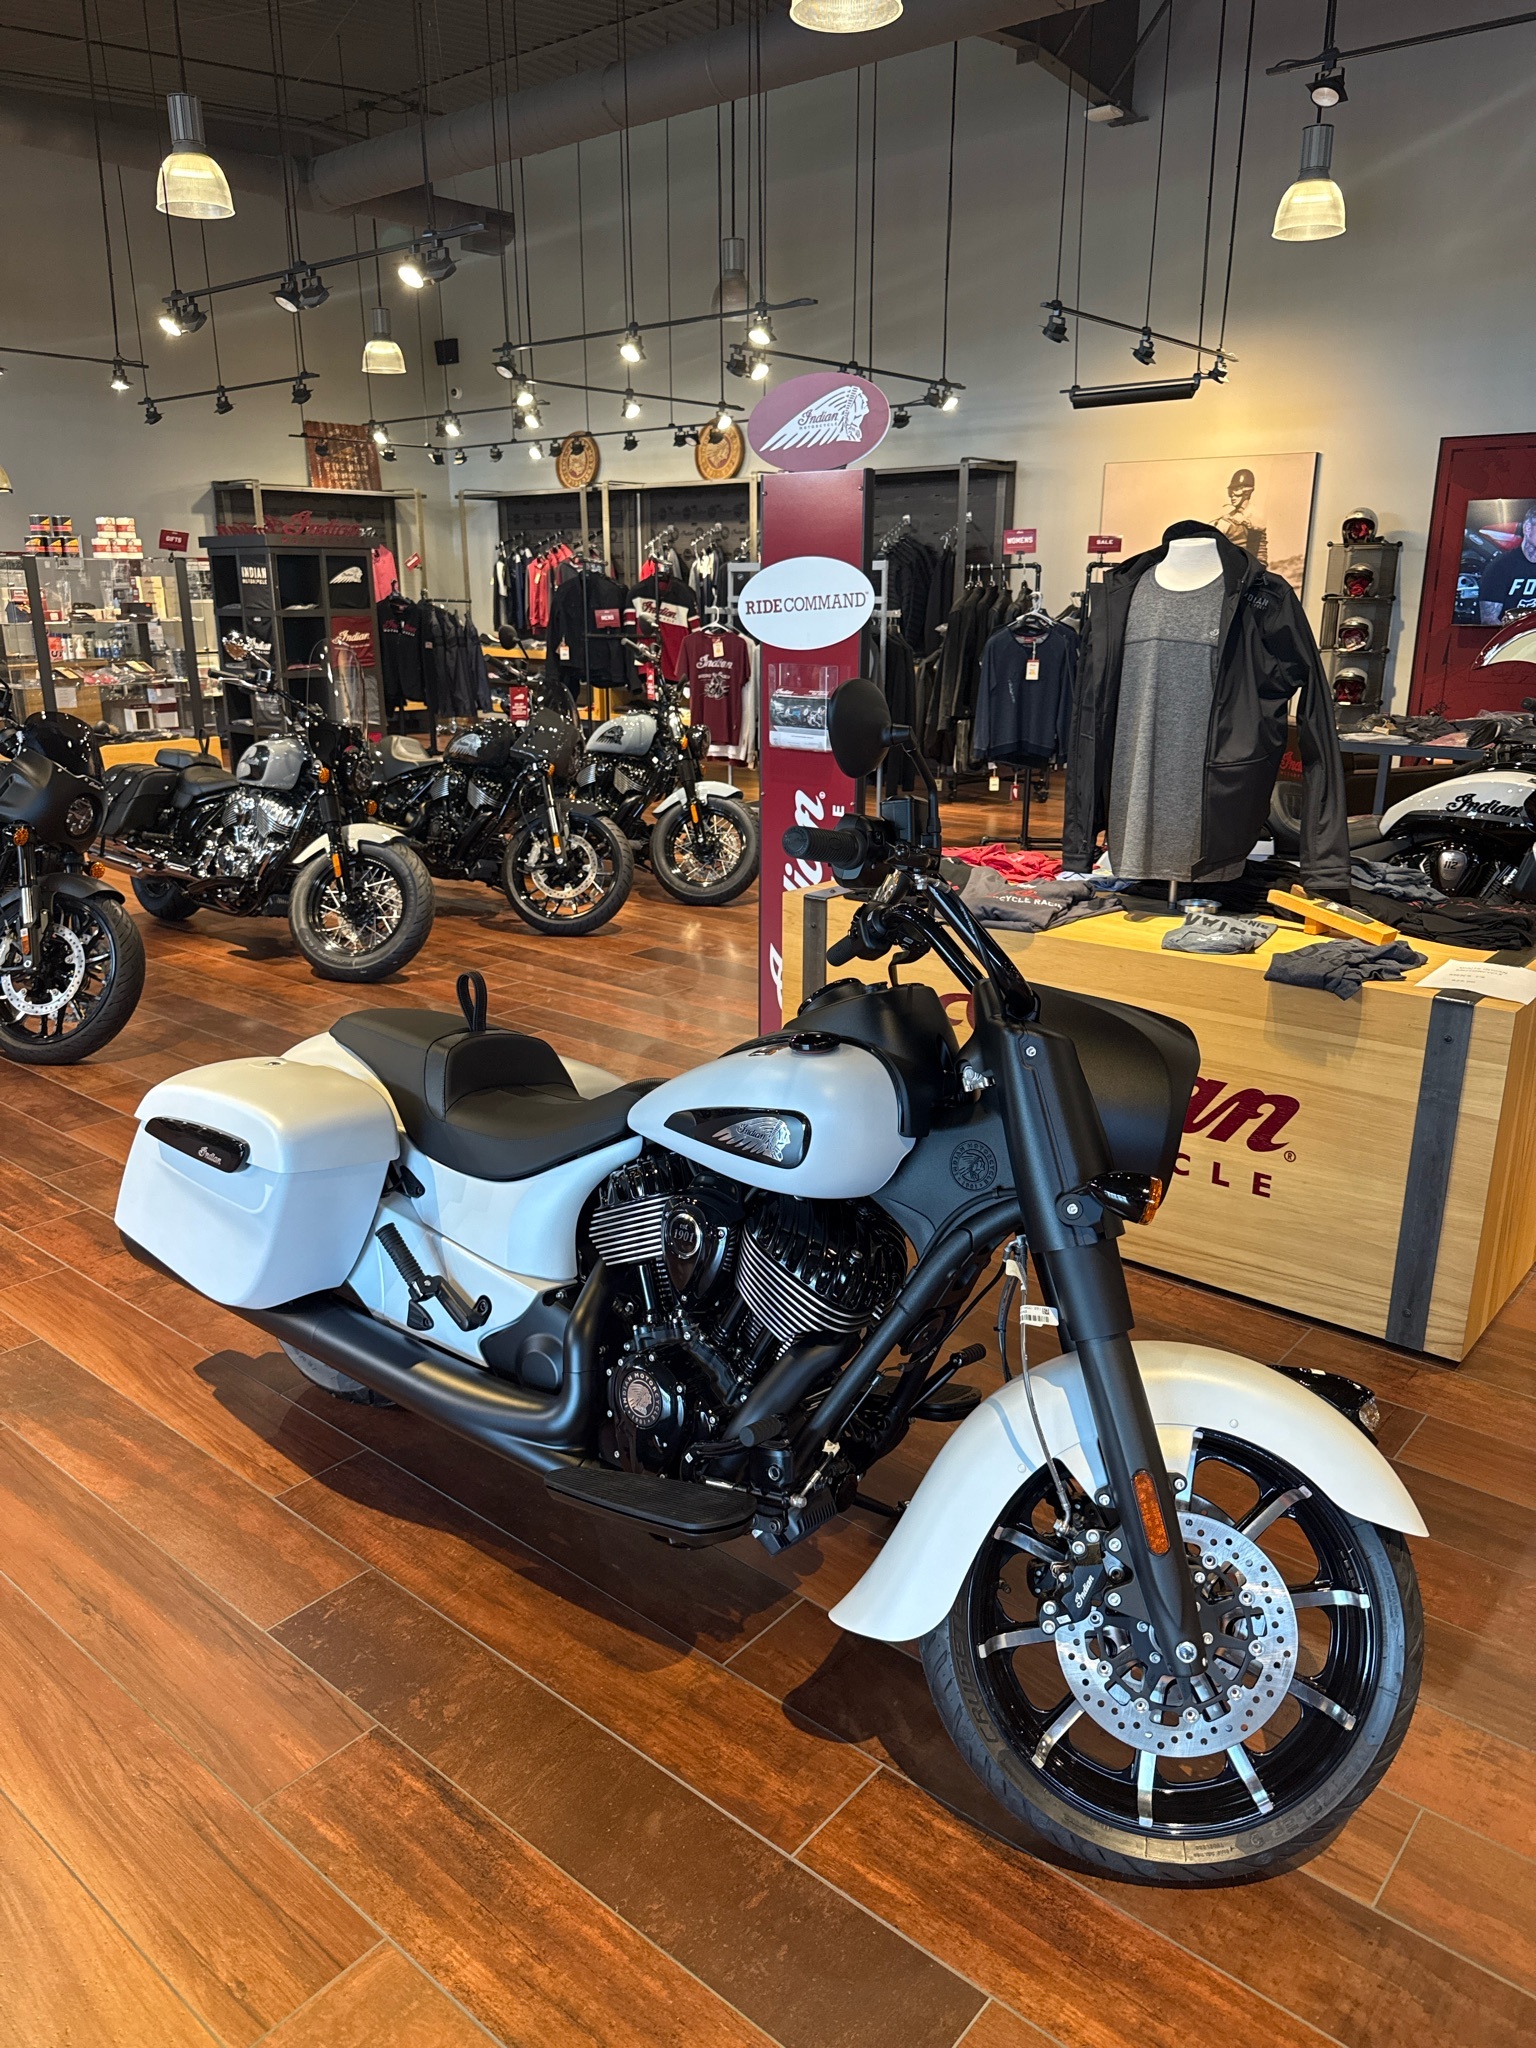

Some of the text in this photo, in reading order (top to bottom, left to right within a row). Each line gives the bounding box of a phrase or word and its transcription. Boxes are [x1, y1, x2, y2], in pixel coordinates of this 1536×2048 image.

[798, 409, 838, 425] Indian
[799, 422, 838, 430] MOTORCYCLE
[1007, 536, 1033, 544] WOMENS
[241, 566, 267, 579] INDIAN
[1508, 579, 1536, 596] FO
[332, 630, 370, 644] Indian
[696, 654, 733, 670] Indian
[1445, 793, 1524, 818] Indian
[1443, 861, 1458, 870] 112
[736, 1123, 767, 1140] Indian
[198, 1146, 222, 1165] Indian
[673, 1228, 695, 1243] 1901
[622, 1372, 660, 1421] INDIAN MOTORCYCLE
[1074, 1574, 1095, 1609] Indian
